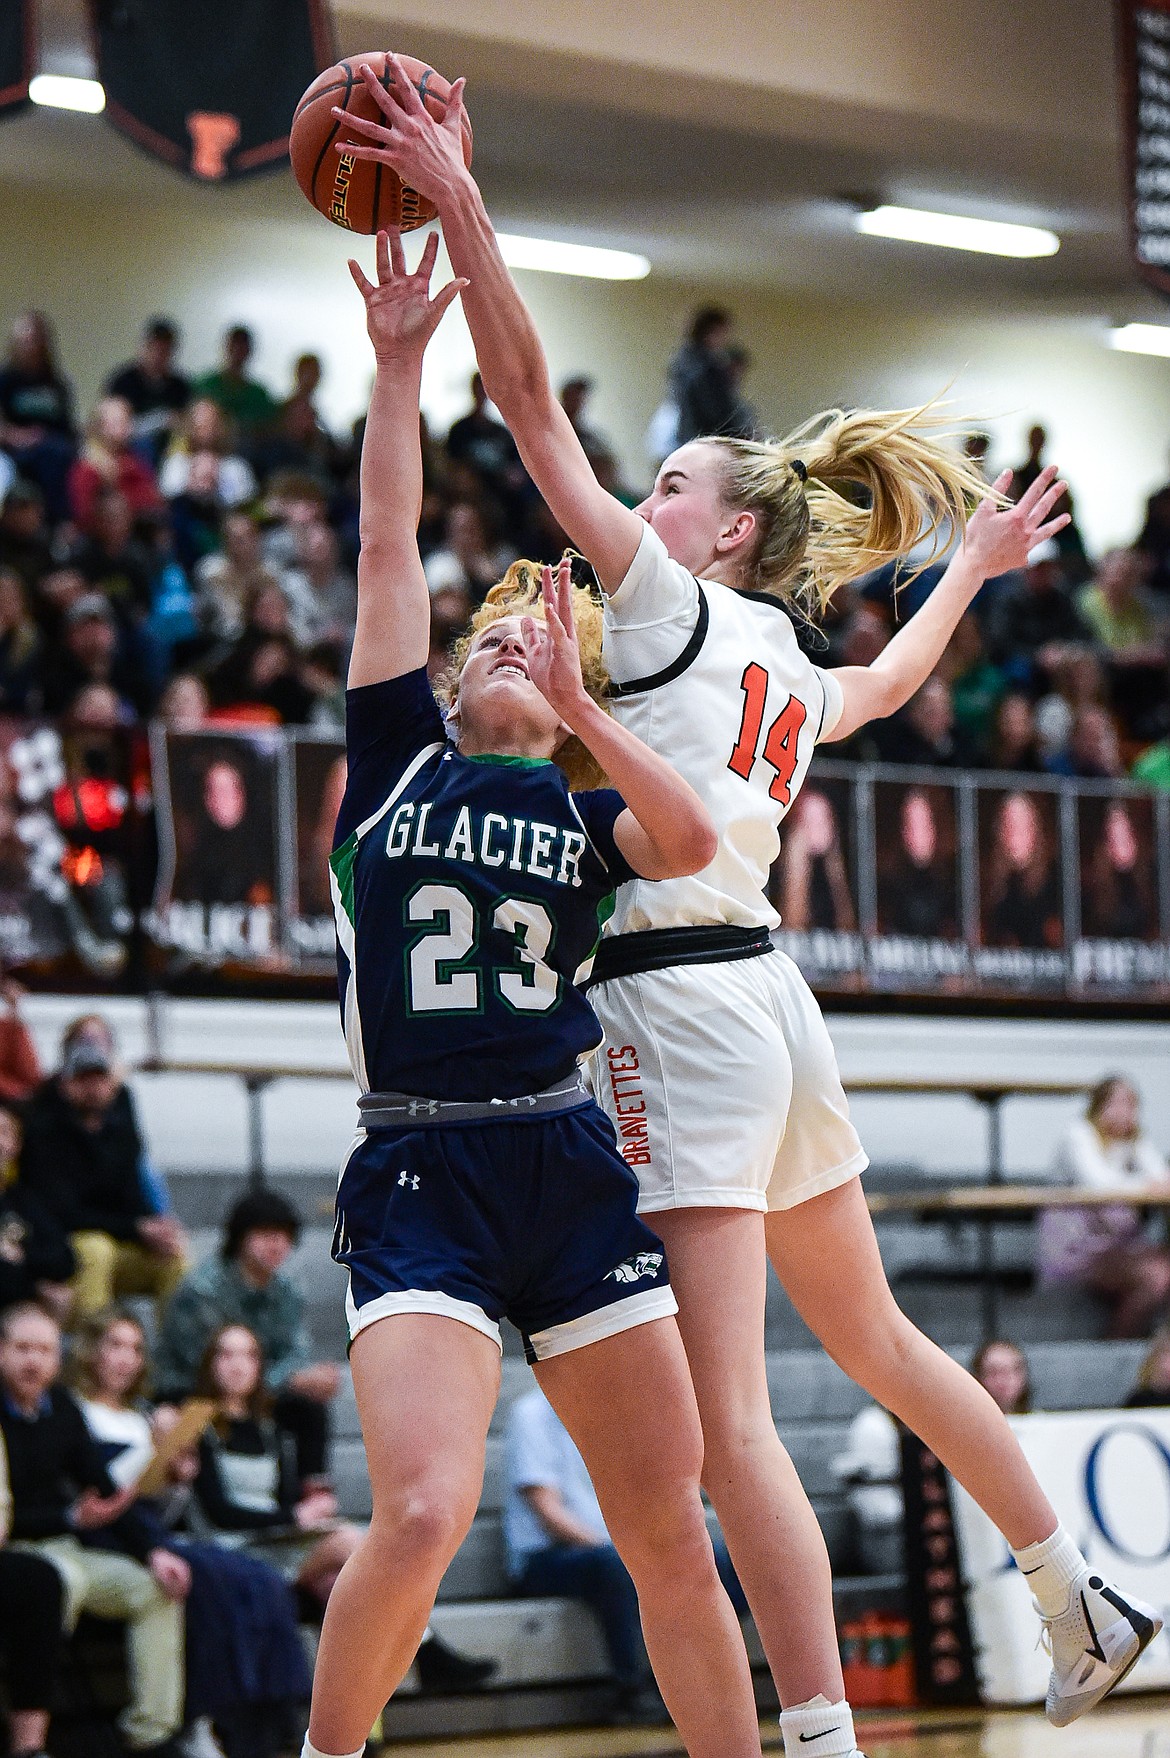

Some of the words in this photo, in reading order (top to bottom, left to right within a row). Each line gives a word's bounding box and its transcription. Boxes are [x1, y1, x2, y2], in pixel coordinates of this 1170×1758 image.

[727, 660, 807, 808] 14
[384, 801, 587, 888] GLACIER
[403, 878, 564, 1018] 23
[607, 1045, 652, 1166] BRAVETTES
